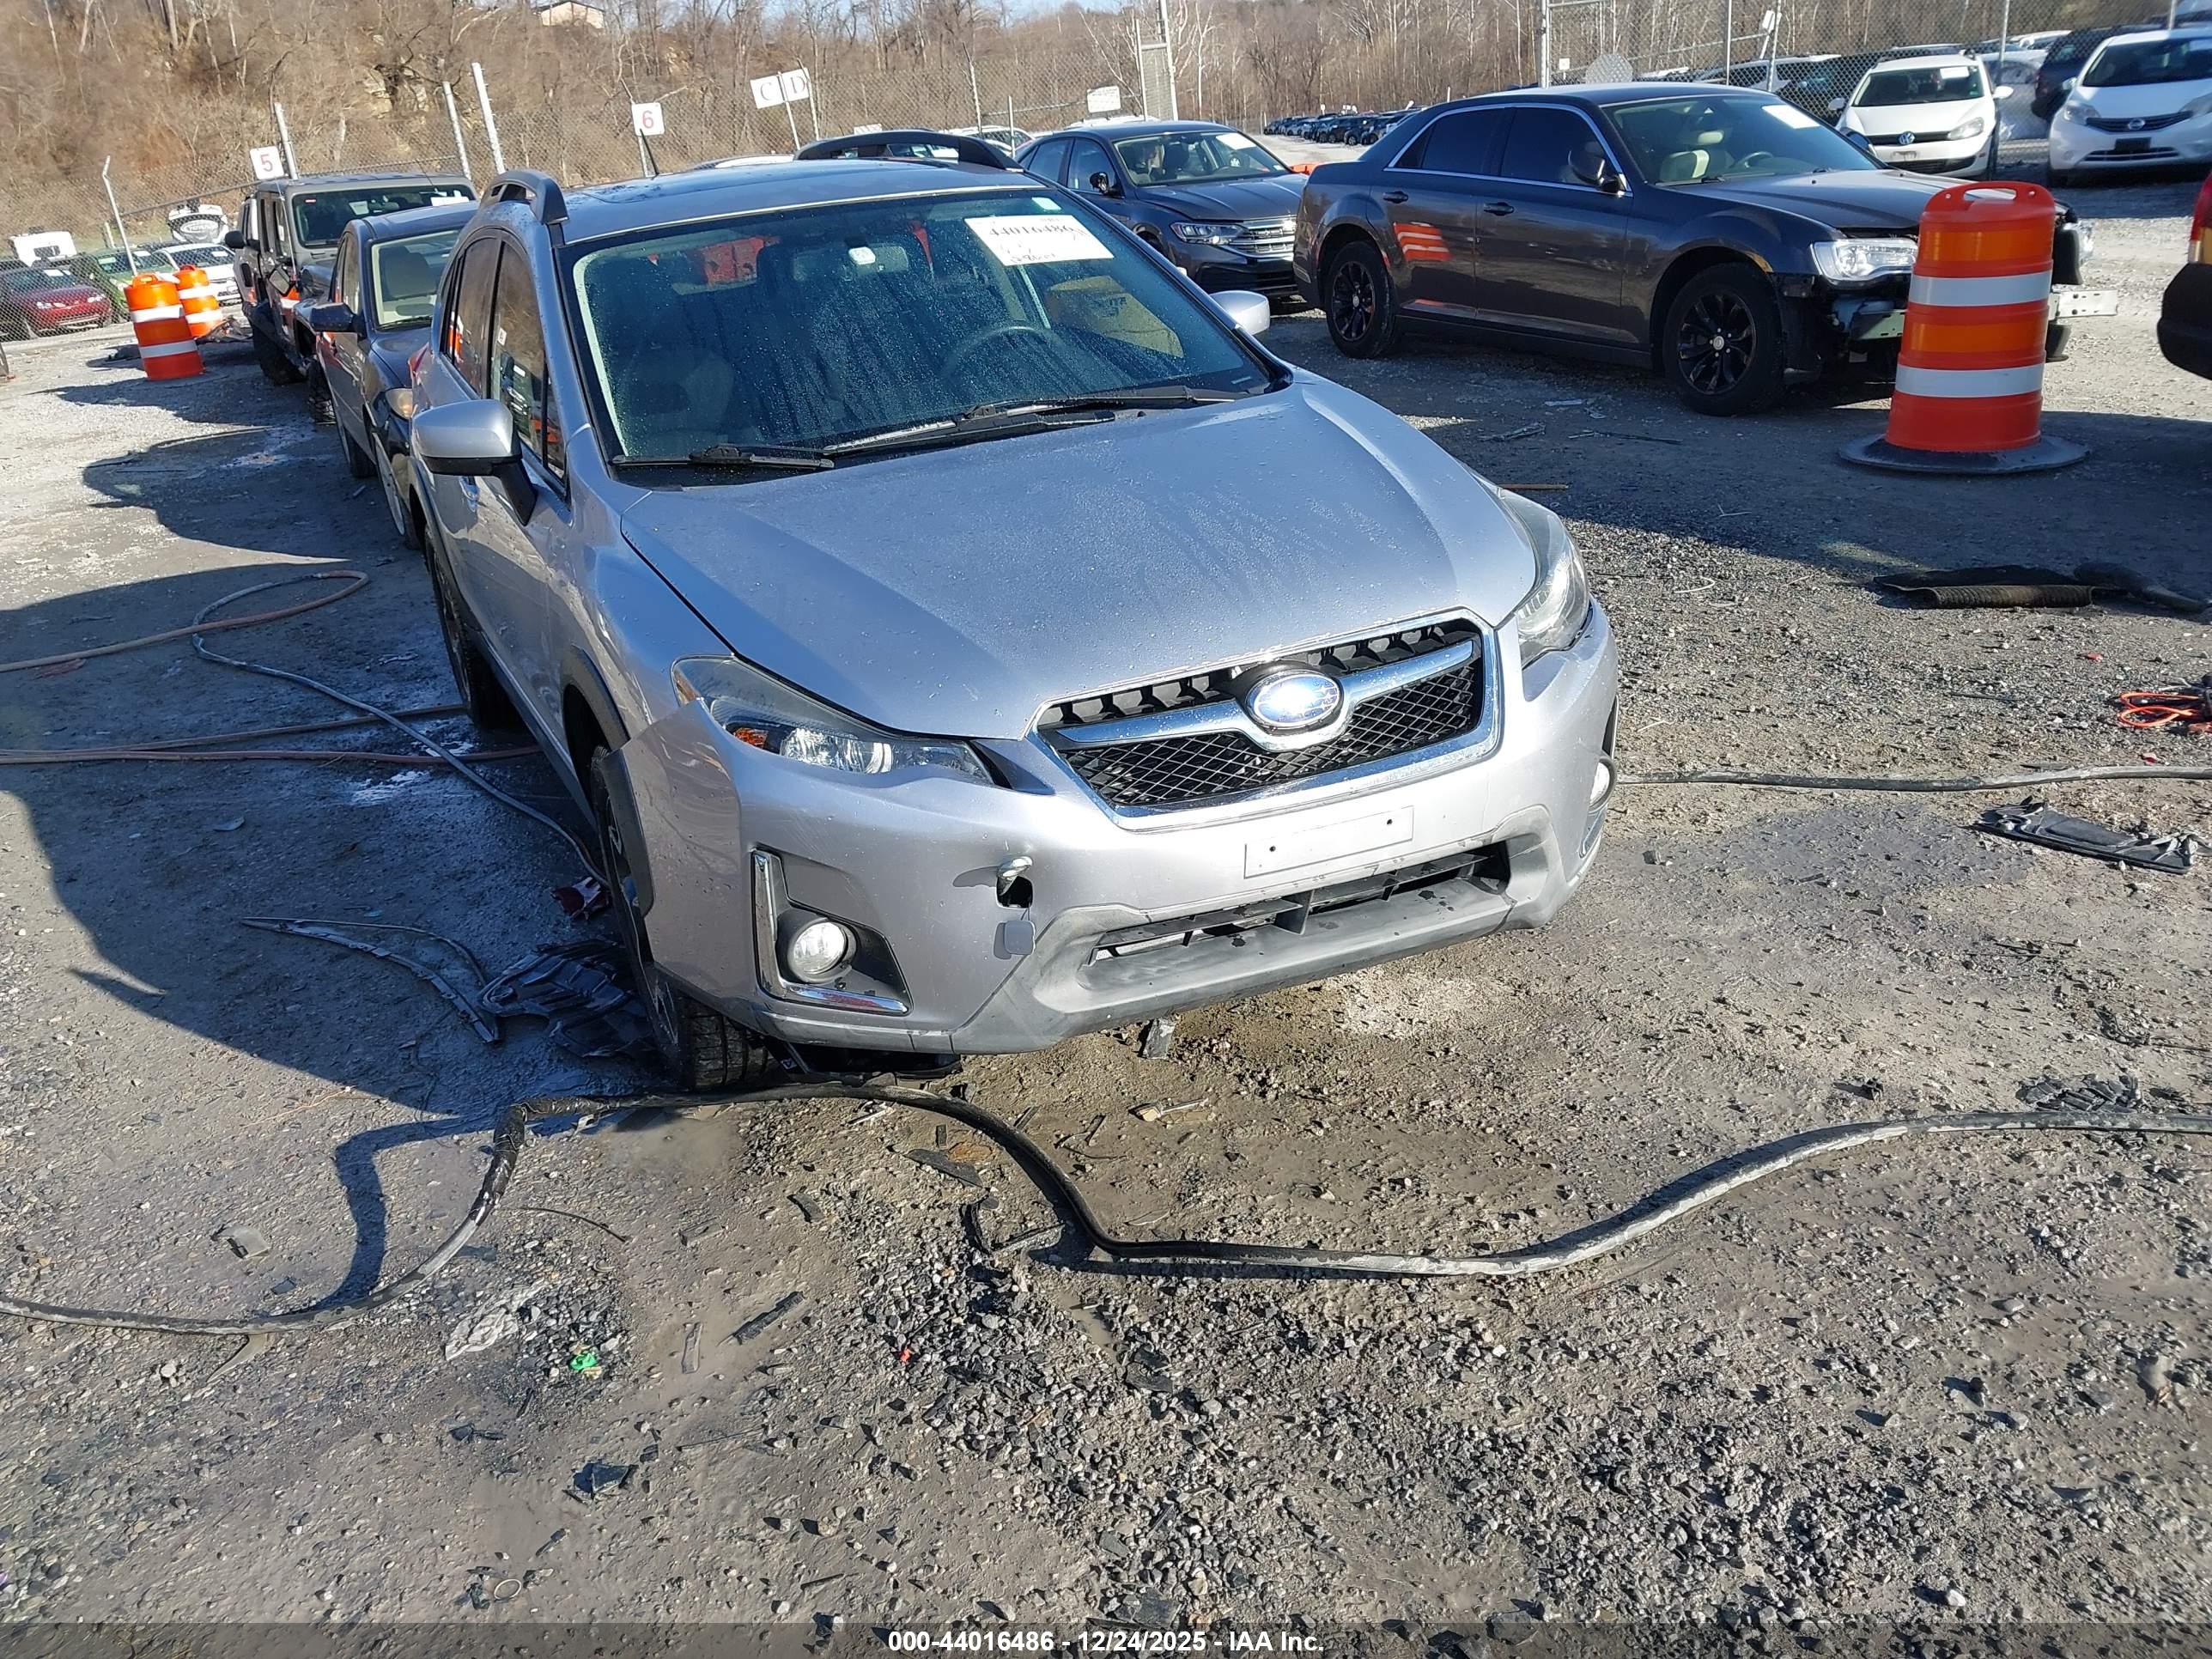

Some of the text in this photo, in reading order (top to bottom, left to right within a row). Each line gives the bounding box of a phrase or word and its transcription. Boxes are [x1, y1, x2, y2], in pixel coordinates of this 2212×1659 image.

[760, 82, 773, 101] C
[790, 76, 807, 94] D
[642, 110, 654, 129] 6
[260, 154, 273, 172] 5
